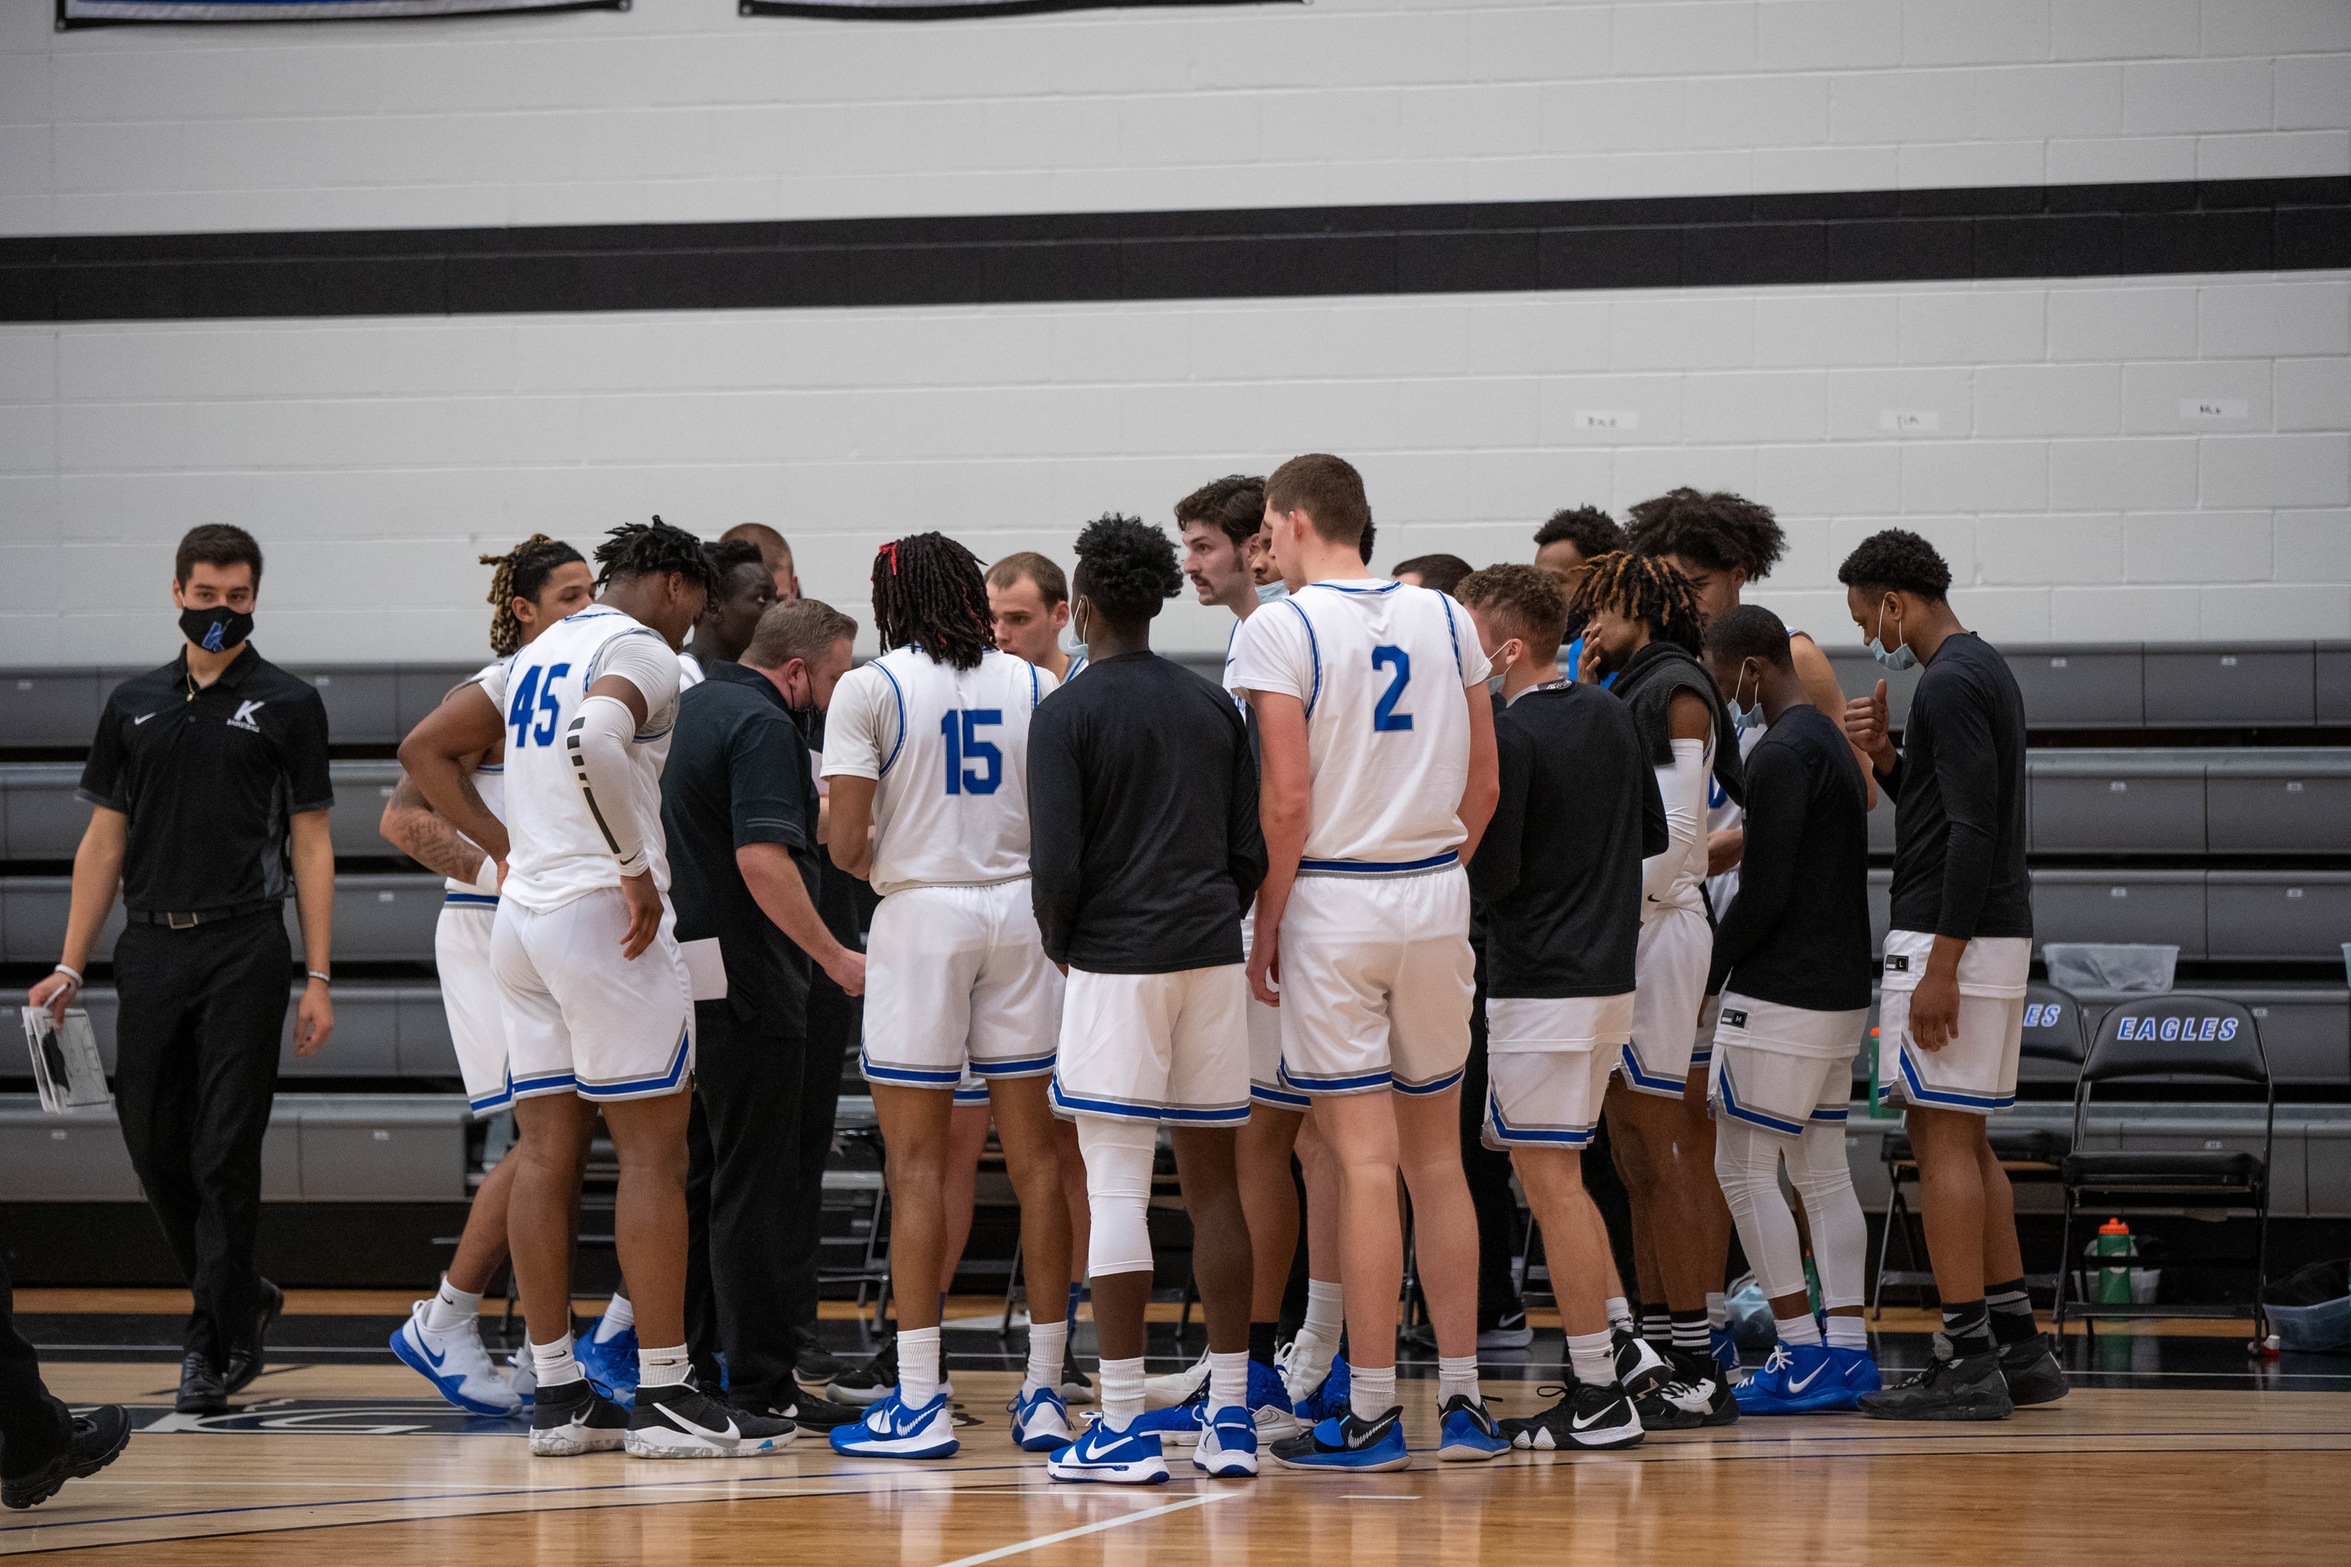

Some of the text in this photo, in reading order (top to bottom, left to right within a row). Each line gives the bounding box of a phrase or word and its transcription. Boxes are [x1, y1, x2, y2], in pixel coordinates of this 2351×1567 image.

[233, 700, 265, 726] K
[508, 662, 572, 749] 45
[1371, 644, 1414, 733] 2
[940, 708, 1004, 796] 15
[2117, 1016, 2239, 1042] EAGLES
